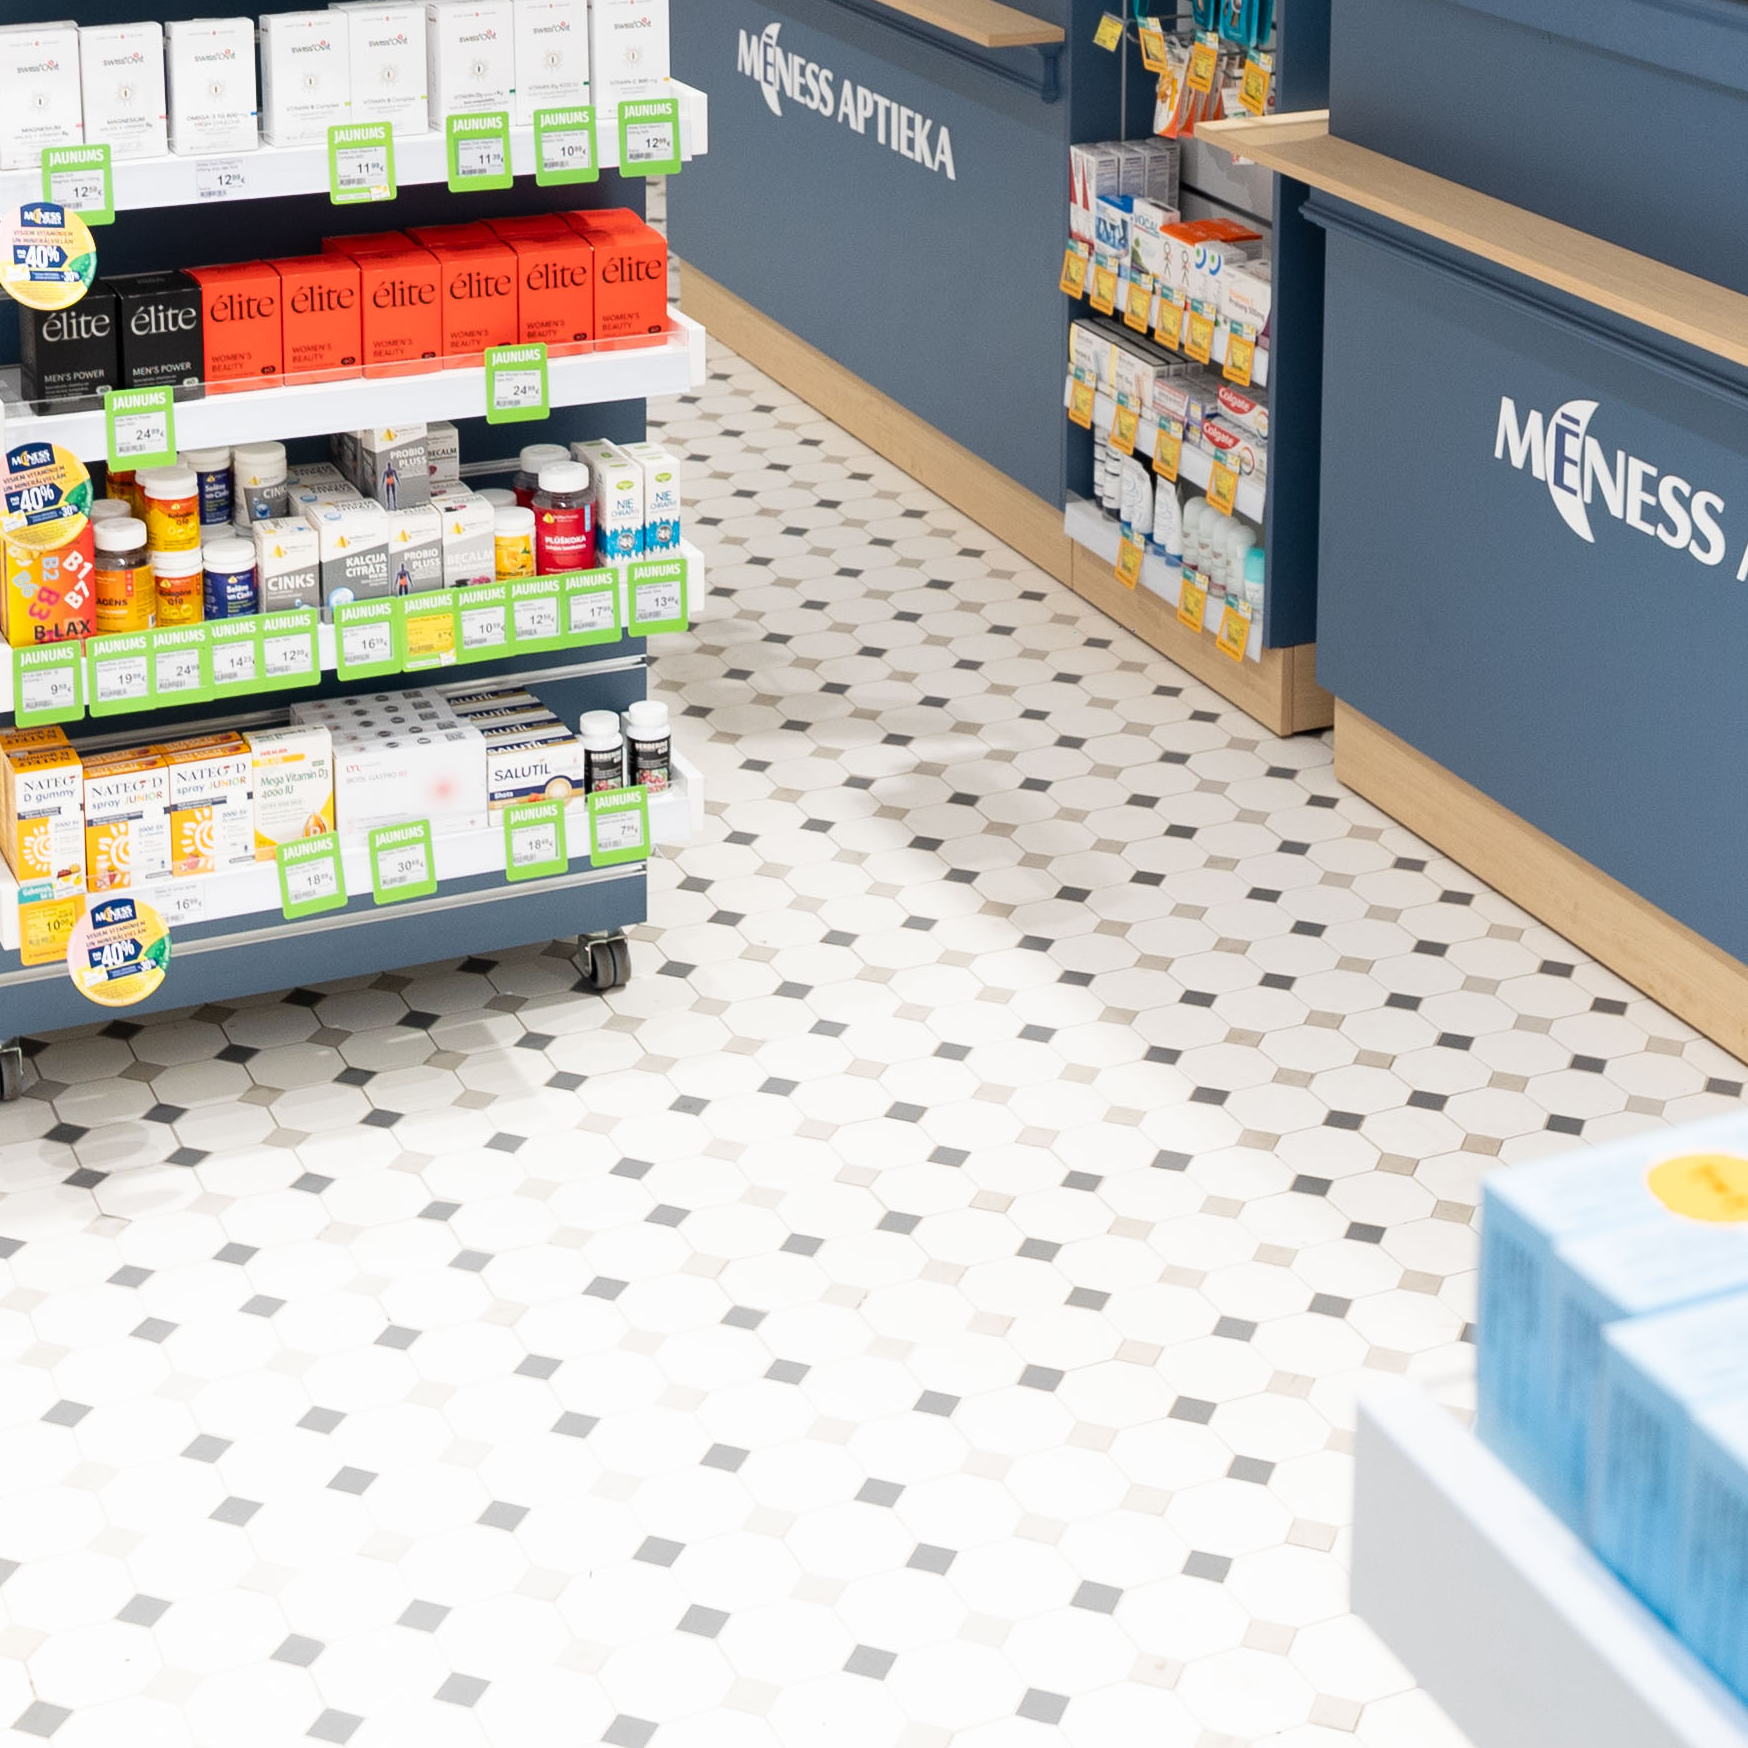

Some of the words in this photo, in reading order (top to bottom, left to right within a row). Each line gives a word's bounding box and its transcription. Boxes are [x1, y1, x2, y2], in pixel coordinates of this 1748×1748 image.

[624, 102, 673, 119] JAUNUMS
[738, 25, 834, 117] MĒNESS
[838, 79, 956, 182] APTIEKA
[453, 115, 503, 133] JAUNUMS
[540, 110, 589, 127] JAUNUMS
[334, 127, 386, 144] JAUNUMS
[1134, 212, 1159, 238] VOCAL
[25, 246, 60, 268] 40%
[527, 263, 587, 292] élite
[602, 257, 662, 284] élite
[372, 280, 435, 309] élite
[449, 271, 511, 301] élite
[210, 293, 274, 323] élite
[291, 285, 353, 314] élite
[42, 311, 110, 342] élite
[131, 305, 197, 336] élite
[491, 349, 541, 366] JAUNUMS
[44, 370, 71, 383] MEN'S
[73, 368, 105, 380] POWER
[132, 364, 160, 376] MEN'S
[161, 362, 192, 374] POWER
[112, 391, 166, 411] JAUNUMS
[1219, 387, 1254, 412] Colgate
[1203, 422, 1237, 447] Colgate
[390, 447, 425, 460] PROBIO
[399, 456, 427, 468] PLUSS
[1494, 396, 1726, 566] MĒNESS
[20, 487, 54, 512] 40%
[616, 499, 634, 510] NIE
[654, 491, 672, 502] NIE
[62, 550, 93, 579] B1
[404, 549, 438, 562] PROBIO
[412, 556, 441, 568] PLUSS
[447, 550, 494, 566] BECALM
[42, 556, 59, 582] B2
[346, 561, 387, 577] CITRĀTS
[267, 574, 315, 590] CINKS
[28, 586, 60, 621] B3
[64, 581, 90, 609] B7
[94, 636, 147, 656] JAUNUMS
[154, 628, 206, 648] JAUNUMS
[20, 647, 74, 667] JAUNUMS
[235, 762, 247, 774] D
[494, 763, 552, 783] SALUTIL
[151, 776, 163, 789] D
[176, 783, 204, 796] spray
[208, 775, 247, 791] JUNIOR
[260, 775, 284, 788] Mega
[287, 770, 318, 783] Vitamin
[23, 793, 31, 803] D
[36, 788, 75, 803] gummy
[92, 796, 120, 811] spray
[124, 790, 163, 805] JUNIOR
[261, 788, 282, 799] 4000
[101, 941, 135, 967] 40%
